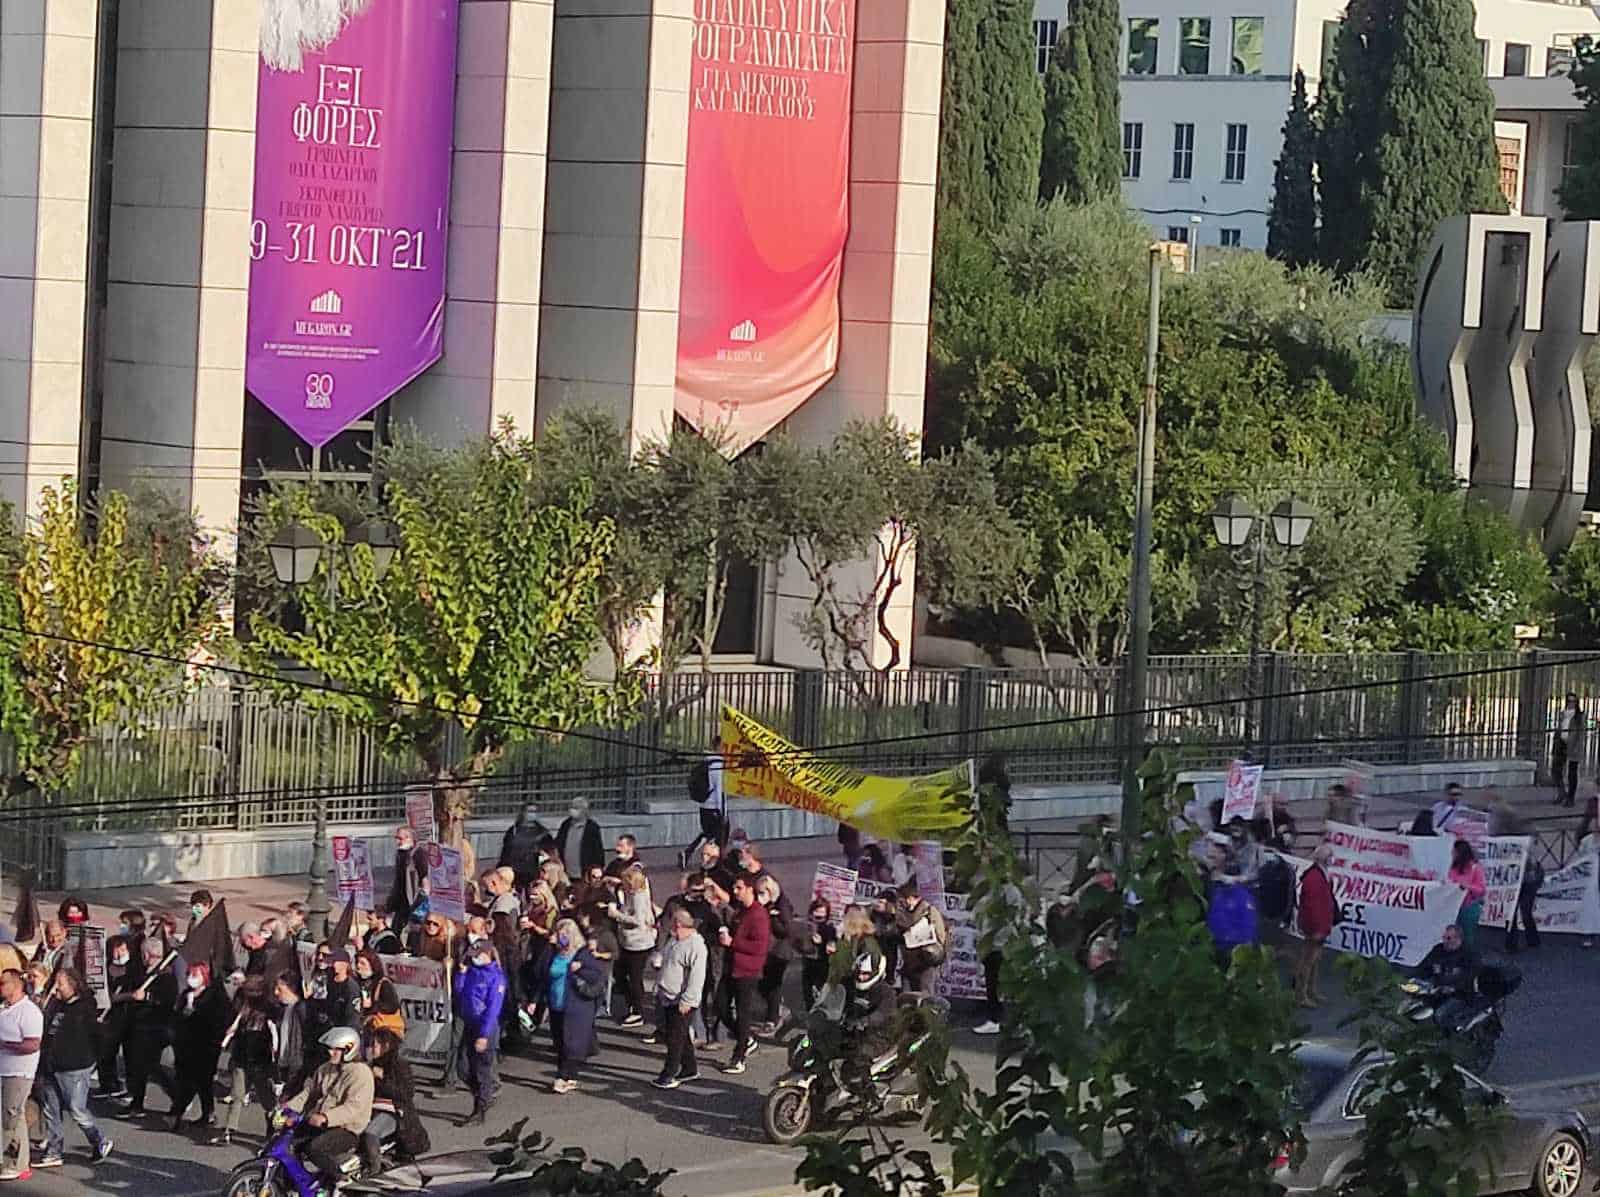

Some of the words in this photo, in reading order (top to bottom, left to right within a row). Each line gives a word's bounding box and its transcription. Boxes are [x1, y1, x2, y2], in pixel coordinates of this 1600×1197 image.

[317, 64, 363, 107] ΕΞΙ
[703, 66, 731, 92] ΓΙΑ
[739, 71, 809, 98] ΜΙΚΡΟΥΣ
[694, 87, 725, 112] ΚΑΙ
[732, 91, 817, 121] ΜΕΓΑΛΟΥΣ
[292, 103, 383, 148] ΦΟΡΕΣ
[329, 225, 427, 271] ΟΚΤ'21
[306, 373, 334, 396] 30
[1340, 926, 1408, 960] ΣΤΑΥΡΟΣ
